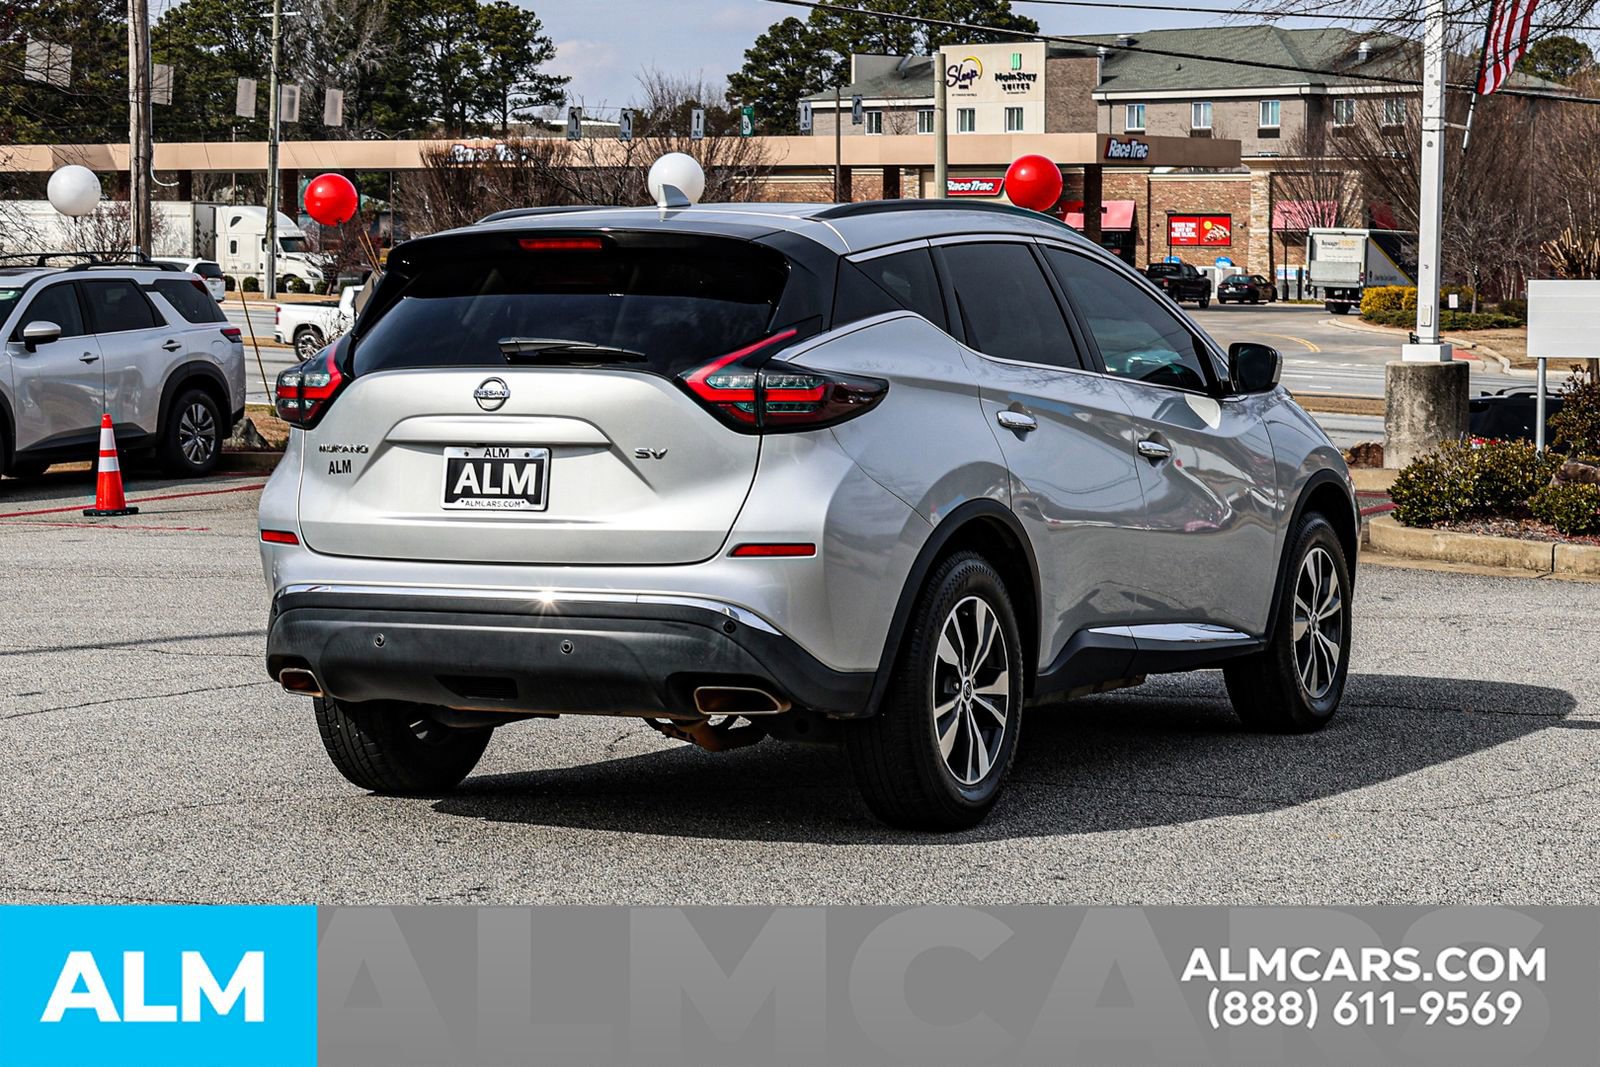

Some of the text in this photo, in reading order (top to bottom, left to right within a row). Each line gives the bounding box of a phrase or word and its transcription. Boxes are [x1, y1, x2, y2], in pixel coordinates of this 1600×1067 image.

[945, 63, 979, 88] Sleep
[995, 72, 1037, 82] MainStay
[1106, 138, 1149, 158] RaceTrac
[319, 444, 369, 454] MURANO
[484, 448, 510, 458] ALM
[635, 448, 668, 459] SV
[328, 460, 352, 475] ALM
[453, 463, 537, 495] ALM
[465, 500, 521, 508] ALMCARS.COM
